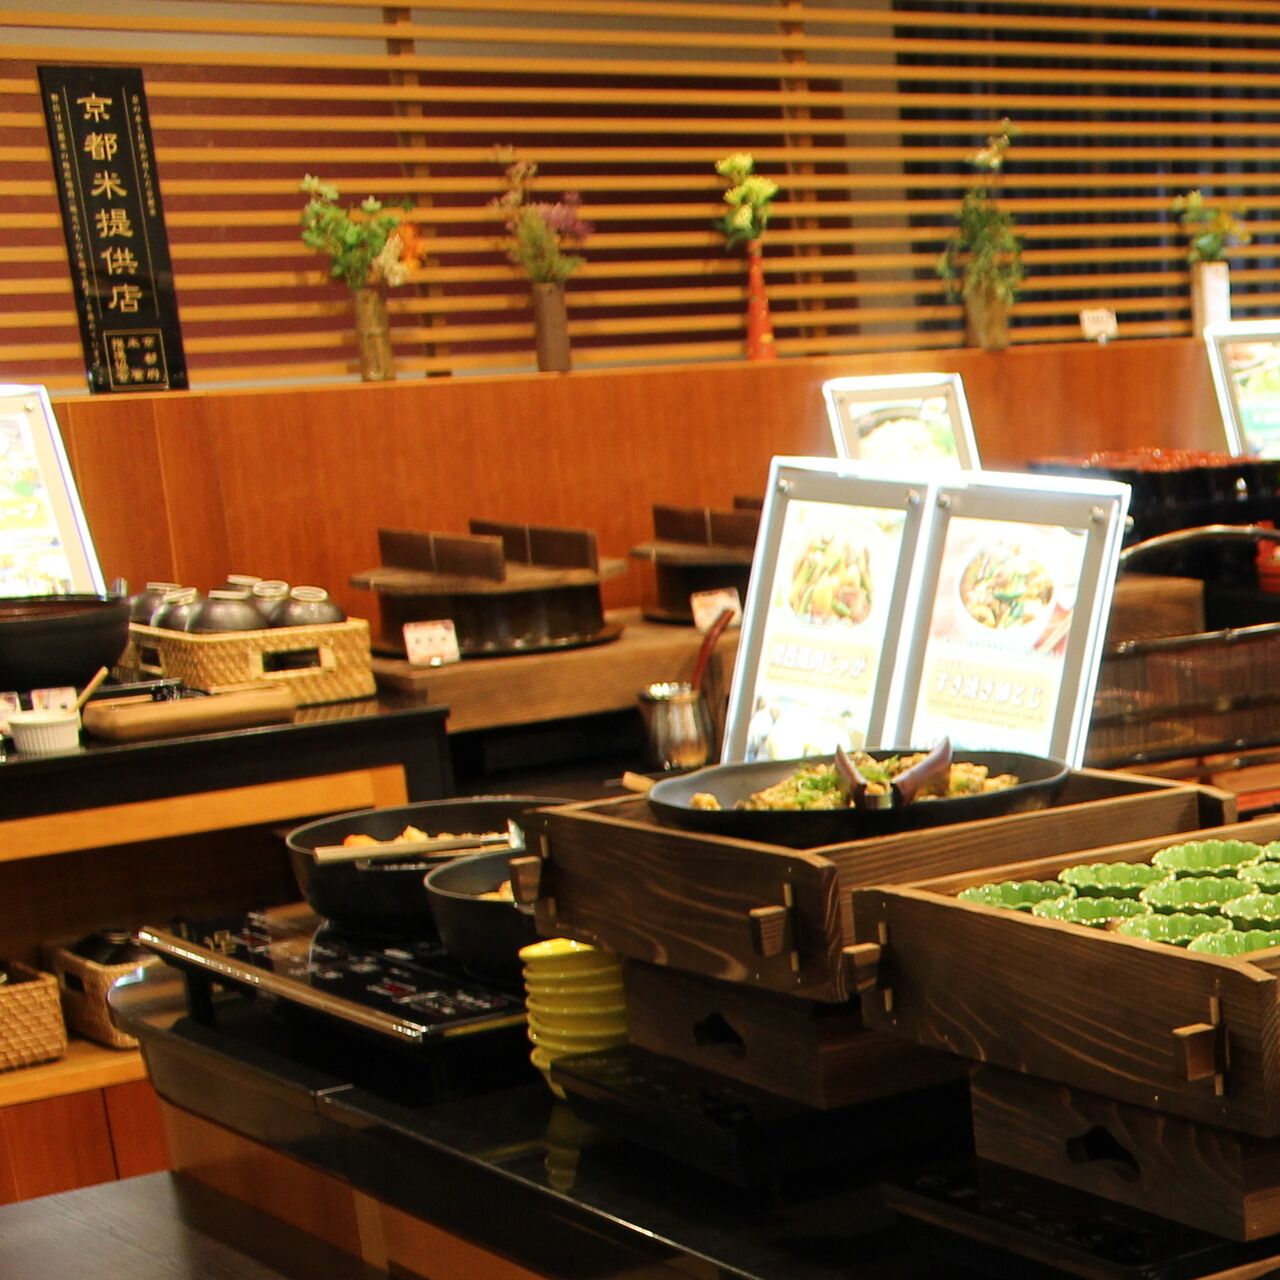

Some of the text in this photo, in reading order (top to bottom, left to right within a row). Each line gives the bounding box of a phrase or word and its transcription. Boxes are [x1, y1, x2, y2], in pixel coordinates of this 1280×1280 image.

[76, 92, 143, 314] 京都米提供店
